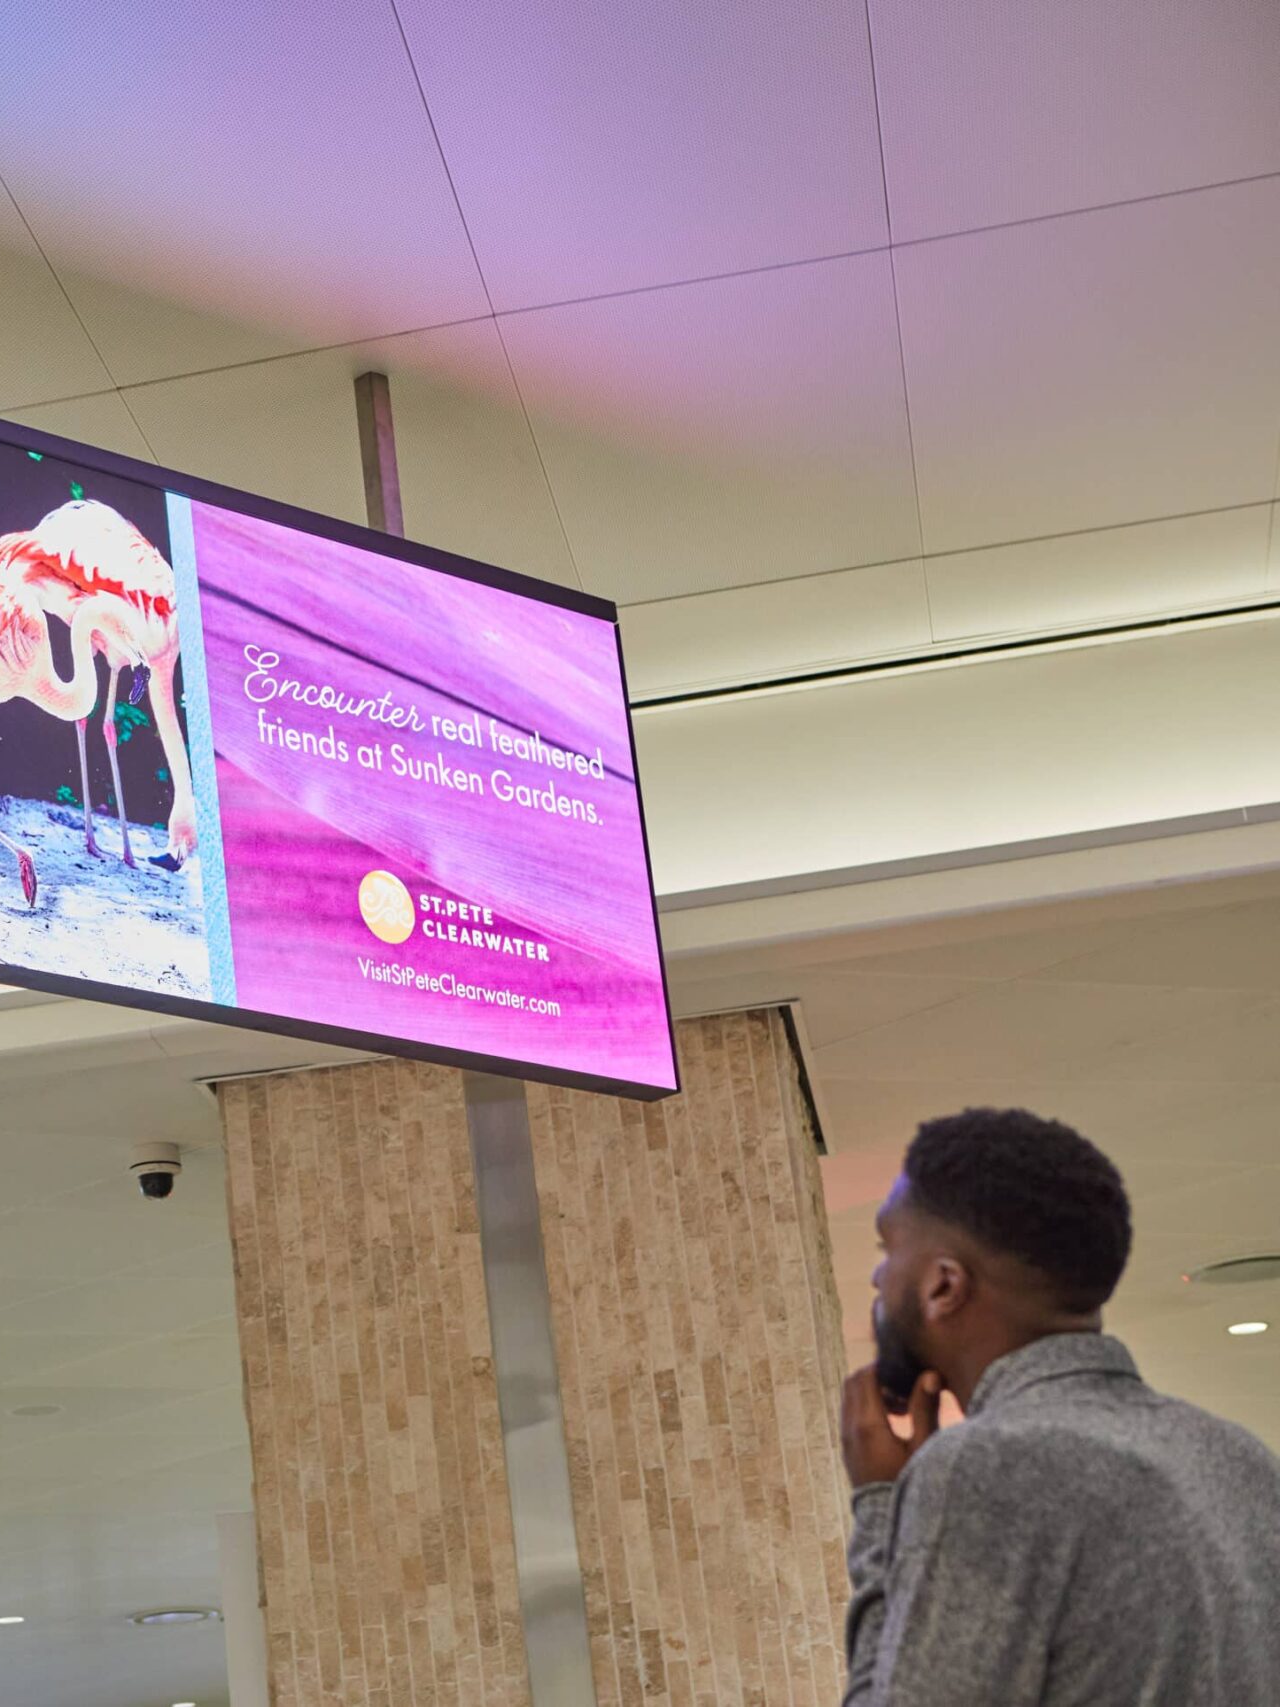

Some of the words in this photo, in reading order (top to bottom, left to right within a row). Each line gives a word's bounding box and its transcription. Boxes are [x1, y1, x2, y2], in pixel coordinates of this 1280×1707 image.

[243, 644, 425, 732] Encounter
[432, 713, 481, 749] real
[490, 719, 605, 780] feathered
[258, 708, 349, 762] friends
[357, 744, 383, 771] at
[391, 744, 484, 795] Sunken
[491, 769, 604, 825] Gardens.
[422, 920, 549, 962] CLEARWATER
[357, 957, 561, 1017] VisitStPeteClearwater.com
